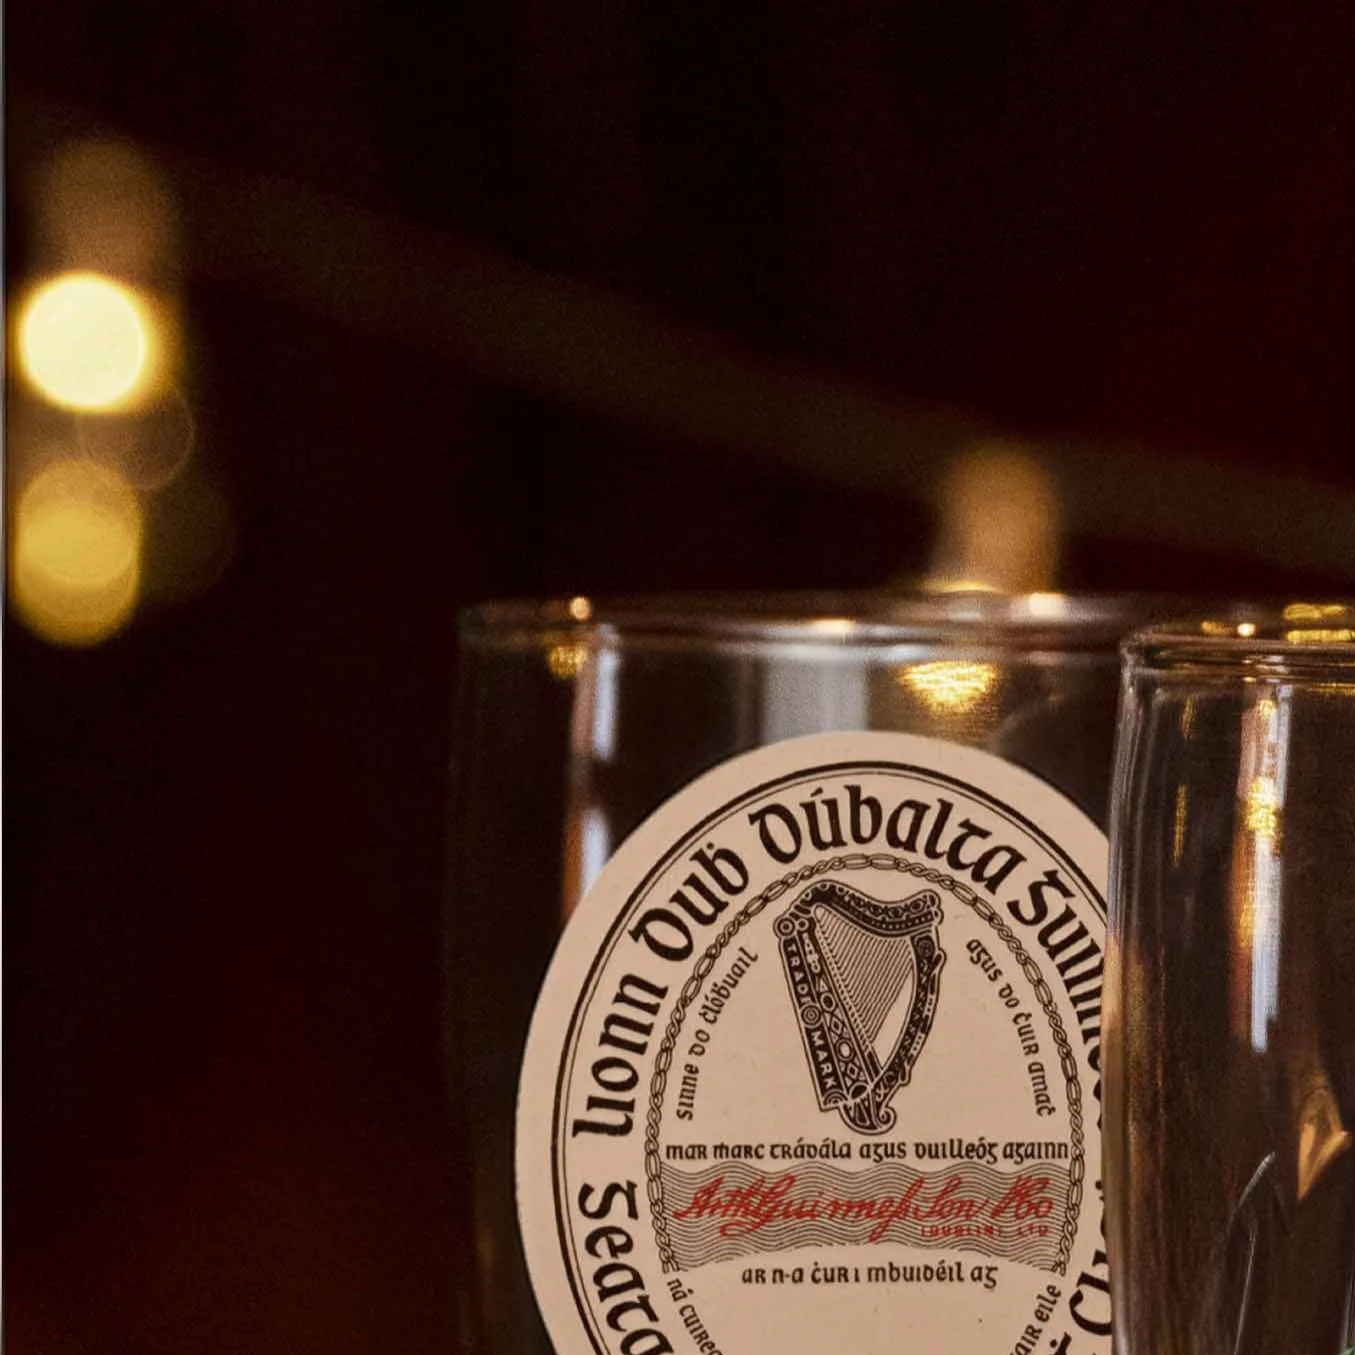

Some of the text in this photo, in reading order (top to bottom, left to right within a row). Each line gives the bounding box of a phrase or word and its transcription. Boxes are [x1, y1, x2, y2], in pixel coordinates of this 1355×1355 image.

[966, 938, 1003, 982] agus
[998, 983, 1020, 1008] do
[688, 1029, 711, 1057] do
[810, 1030, 837, 1089] MARK
[859, 1141, 907, 1163] agus
[1003, 1141, 1069, 1165] againn
[970, 1265, 999, 1289] ag
[1034, 1284, 1062, 1322] eile
